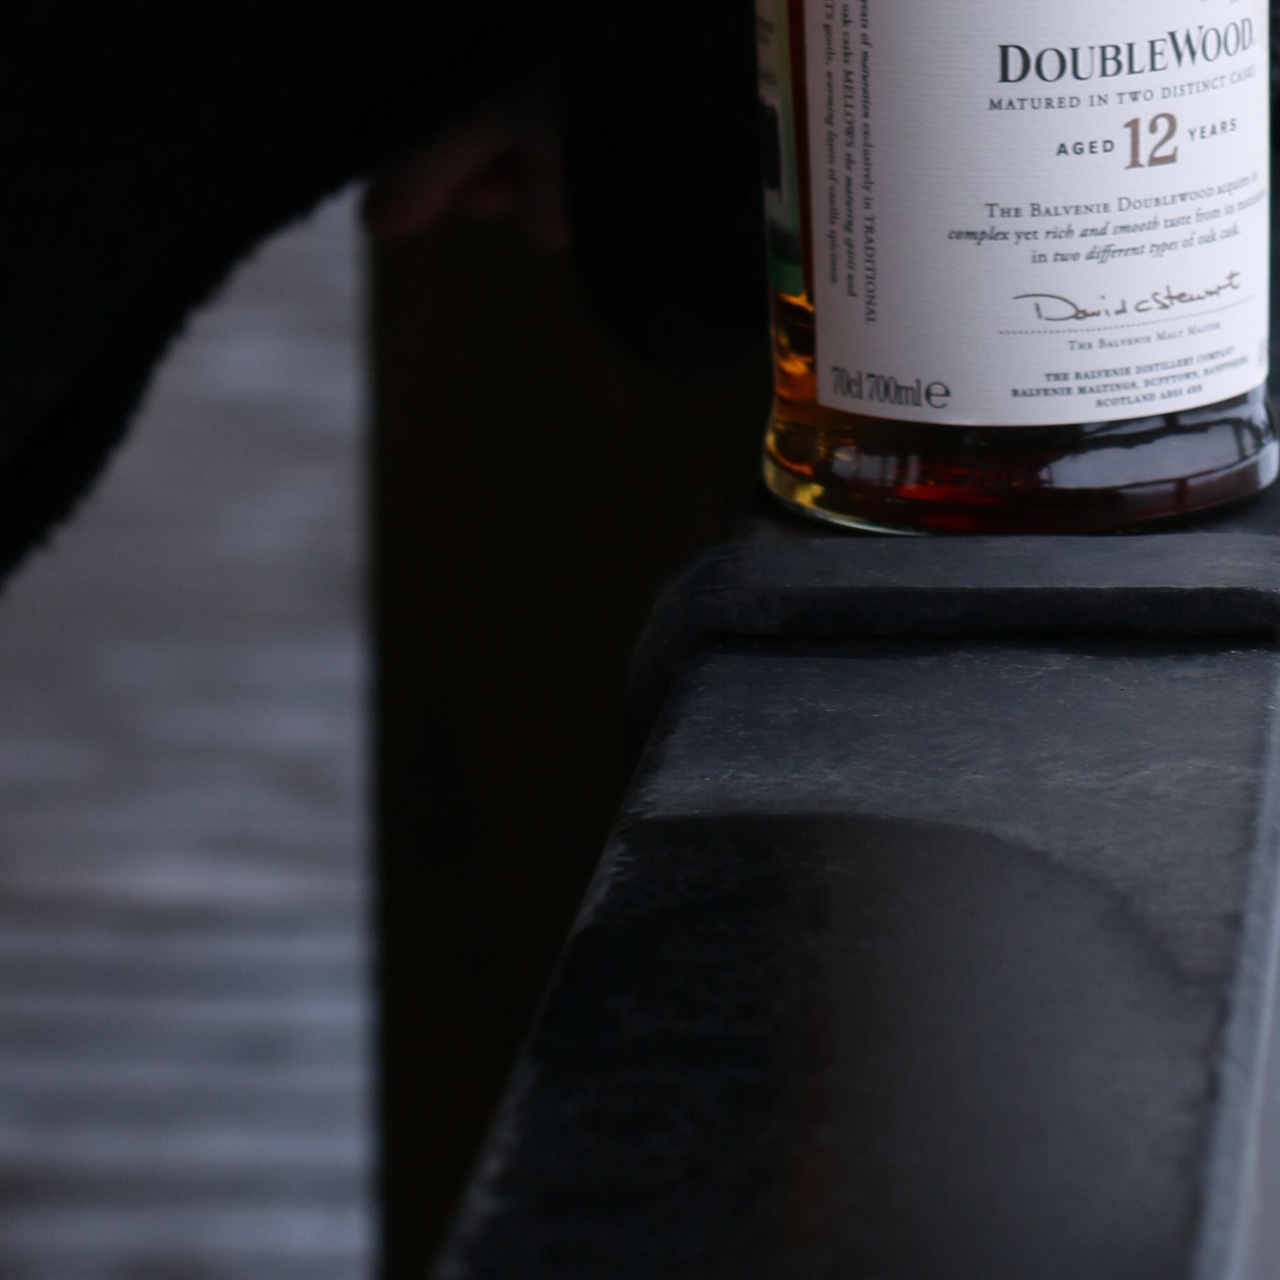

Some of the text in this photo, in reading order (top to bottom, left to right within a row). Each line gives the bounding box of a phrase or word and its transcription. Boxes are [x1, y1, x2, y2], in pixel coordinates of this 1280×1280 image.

[842, 3, 853, 27] oak
[842, 31, 854, 66] casks
[860, 32, 873, 48] of
[996, 16, 1255, 84] DOUBLEWOOD
[825, 70, 837, 127] warming
[861, 50, 872, 119] maturation
[988, 95, 1081, 111] MATURED
[1089, 93, 1109, 108] IN
[1116, 89, 1155, 106] TWO
[1161, 75, 1227, 100] DISTINCT
[843, 69, 855, 148] MELLOWS
[861, 122, 874, 192] exclusively
[1056, 111, 1238, 171] AGED 12 YEARS
[828, 168, 838, 183] of
[845, 152, 856, 171] the
[828, 184, 839, 226] vanilla
[844, 175, 855, 234] maturing
[863, 196, 874, 210] in
[984, 202, 1024, 218] THE
[1029, 201, 1112, 218] BALVENIE
[947, 228, 1010, 246] complex
[1013, 229, 1039, 246] yet
[1045, 225, 1075, 241] rich
[1079, 222, 1110, 238] and
[1112, 218, 1160, 236] smooth
[1031, 249, 1048, 264] in
[1052, 249, 1082, 264] two
[1085, 242, 1146, 265] different
[1181, 231, 1197, 249] of
[846, 273, 858, 298] and
[863, 214, 876, 326] TRADITIONAL
[831, 365, 863, 401] 70cl
[867, 372, 922, 407] 700ml
[1011, 385, 1073, 398] BALVENIE
[1044, 371, 1071, 383] THE
[1073, 366, 1132, 382] BALVENIE
[1095, 393, 1159, 409] SCOTLAND
